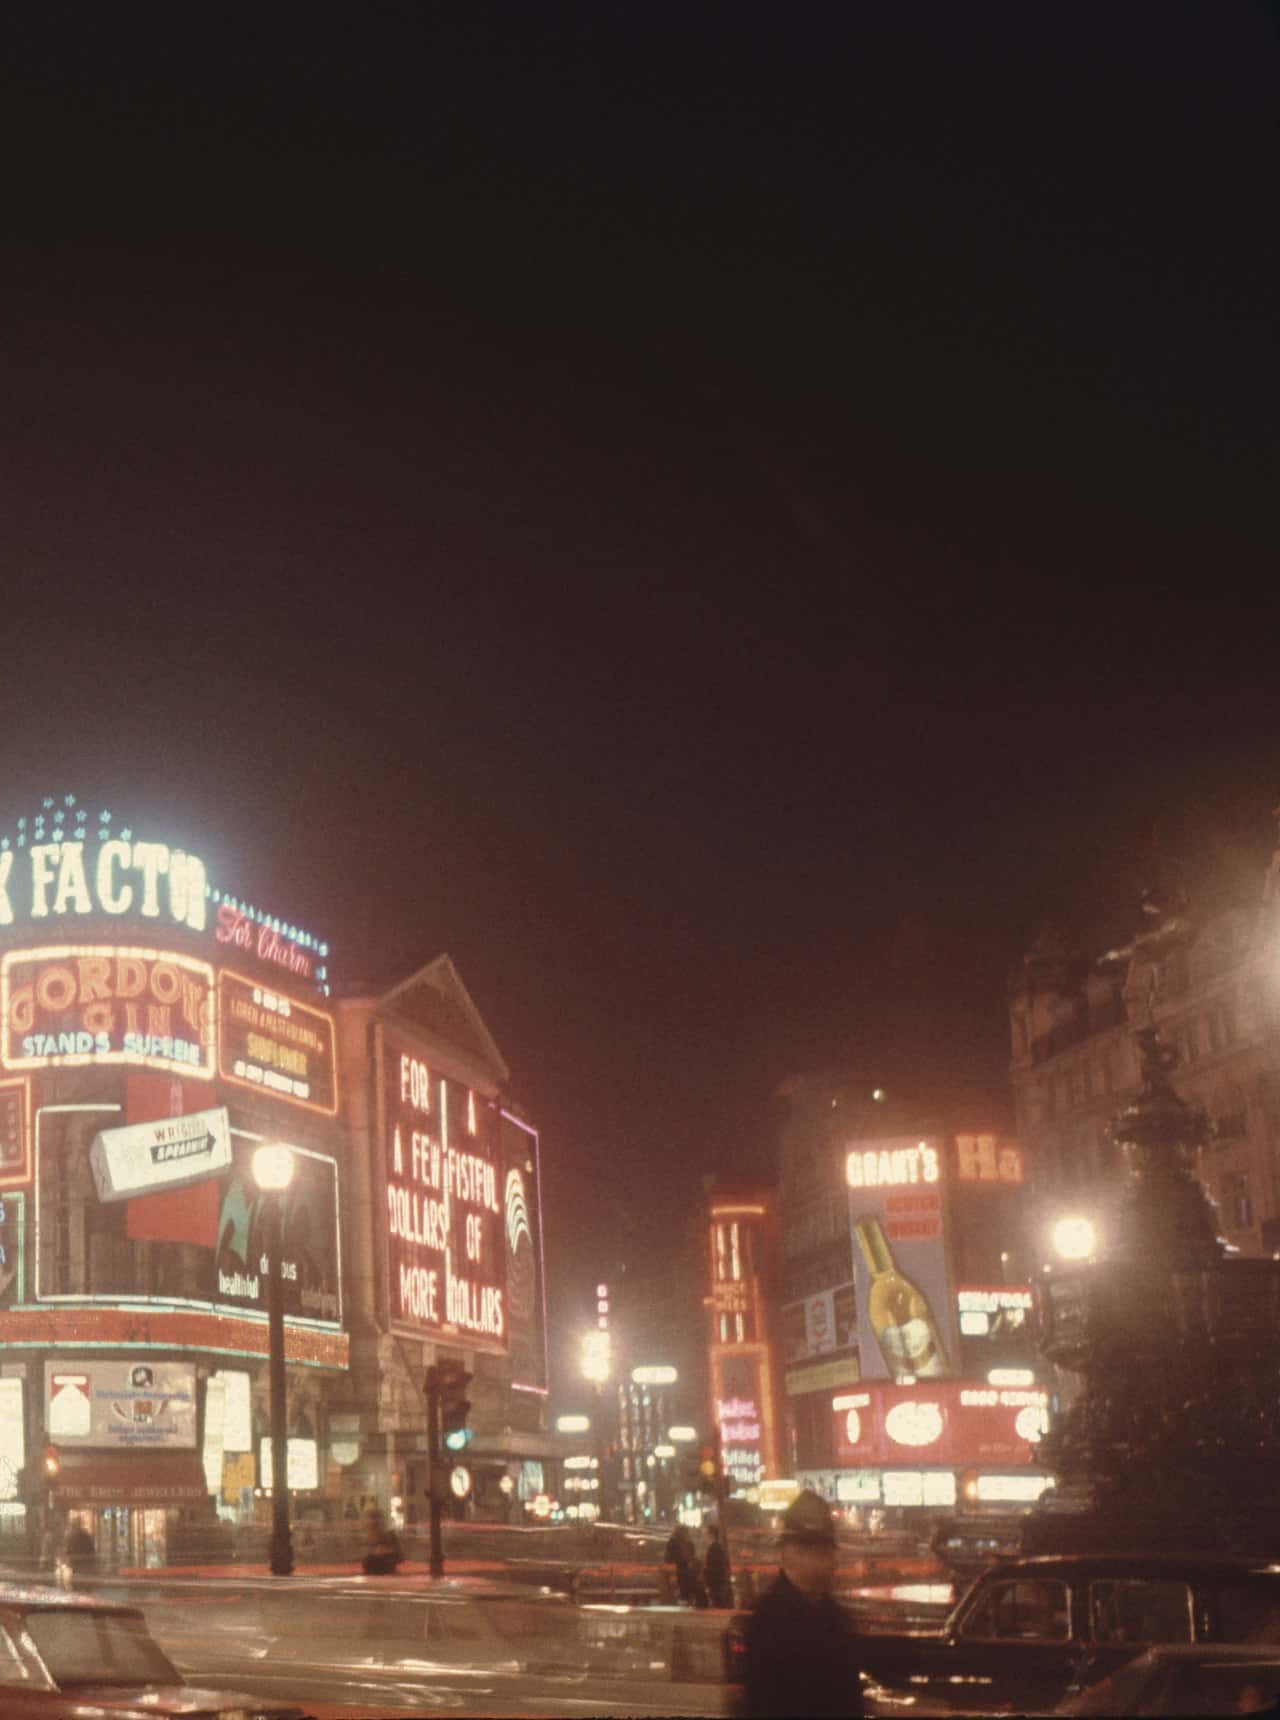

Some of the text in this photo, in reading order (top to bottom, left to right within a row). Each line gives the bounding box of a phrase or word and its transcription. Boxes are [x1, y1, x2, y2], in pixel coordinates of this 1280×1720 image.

[30, 840, 208, 932] FACTOR
[257, 925, 311, 977] Charm
[23, 1031, 110, 1057] STANDS
[83, 1003, 172, 1038] GIN
[400, 1054, 430, 1114] FOR
[467, 1089, 477, 1136] A
[394, 1124, 440, 1190] A FEW
[447, 1147, 500, 1214] FISTFUL
[846, 1142, 939, 1187] GRANT'S
[388, 1184, 448, 1251] DOLLARS
[465, 1212, 483, 1264] OF
[400, 1263, 438, 1324] MORE
[448, 1273, 504, 1338] DOLLARS
